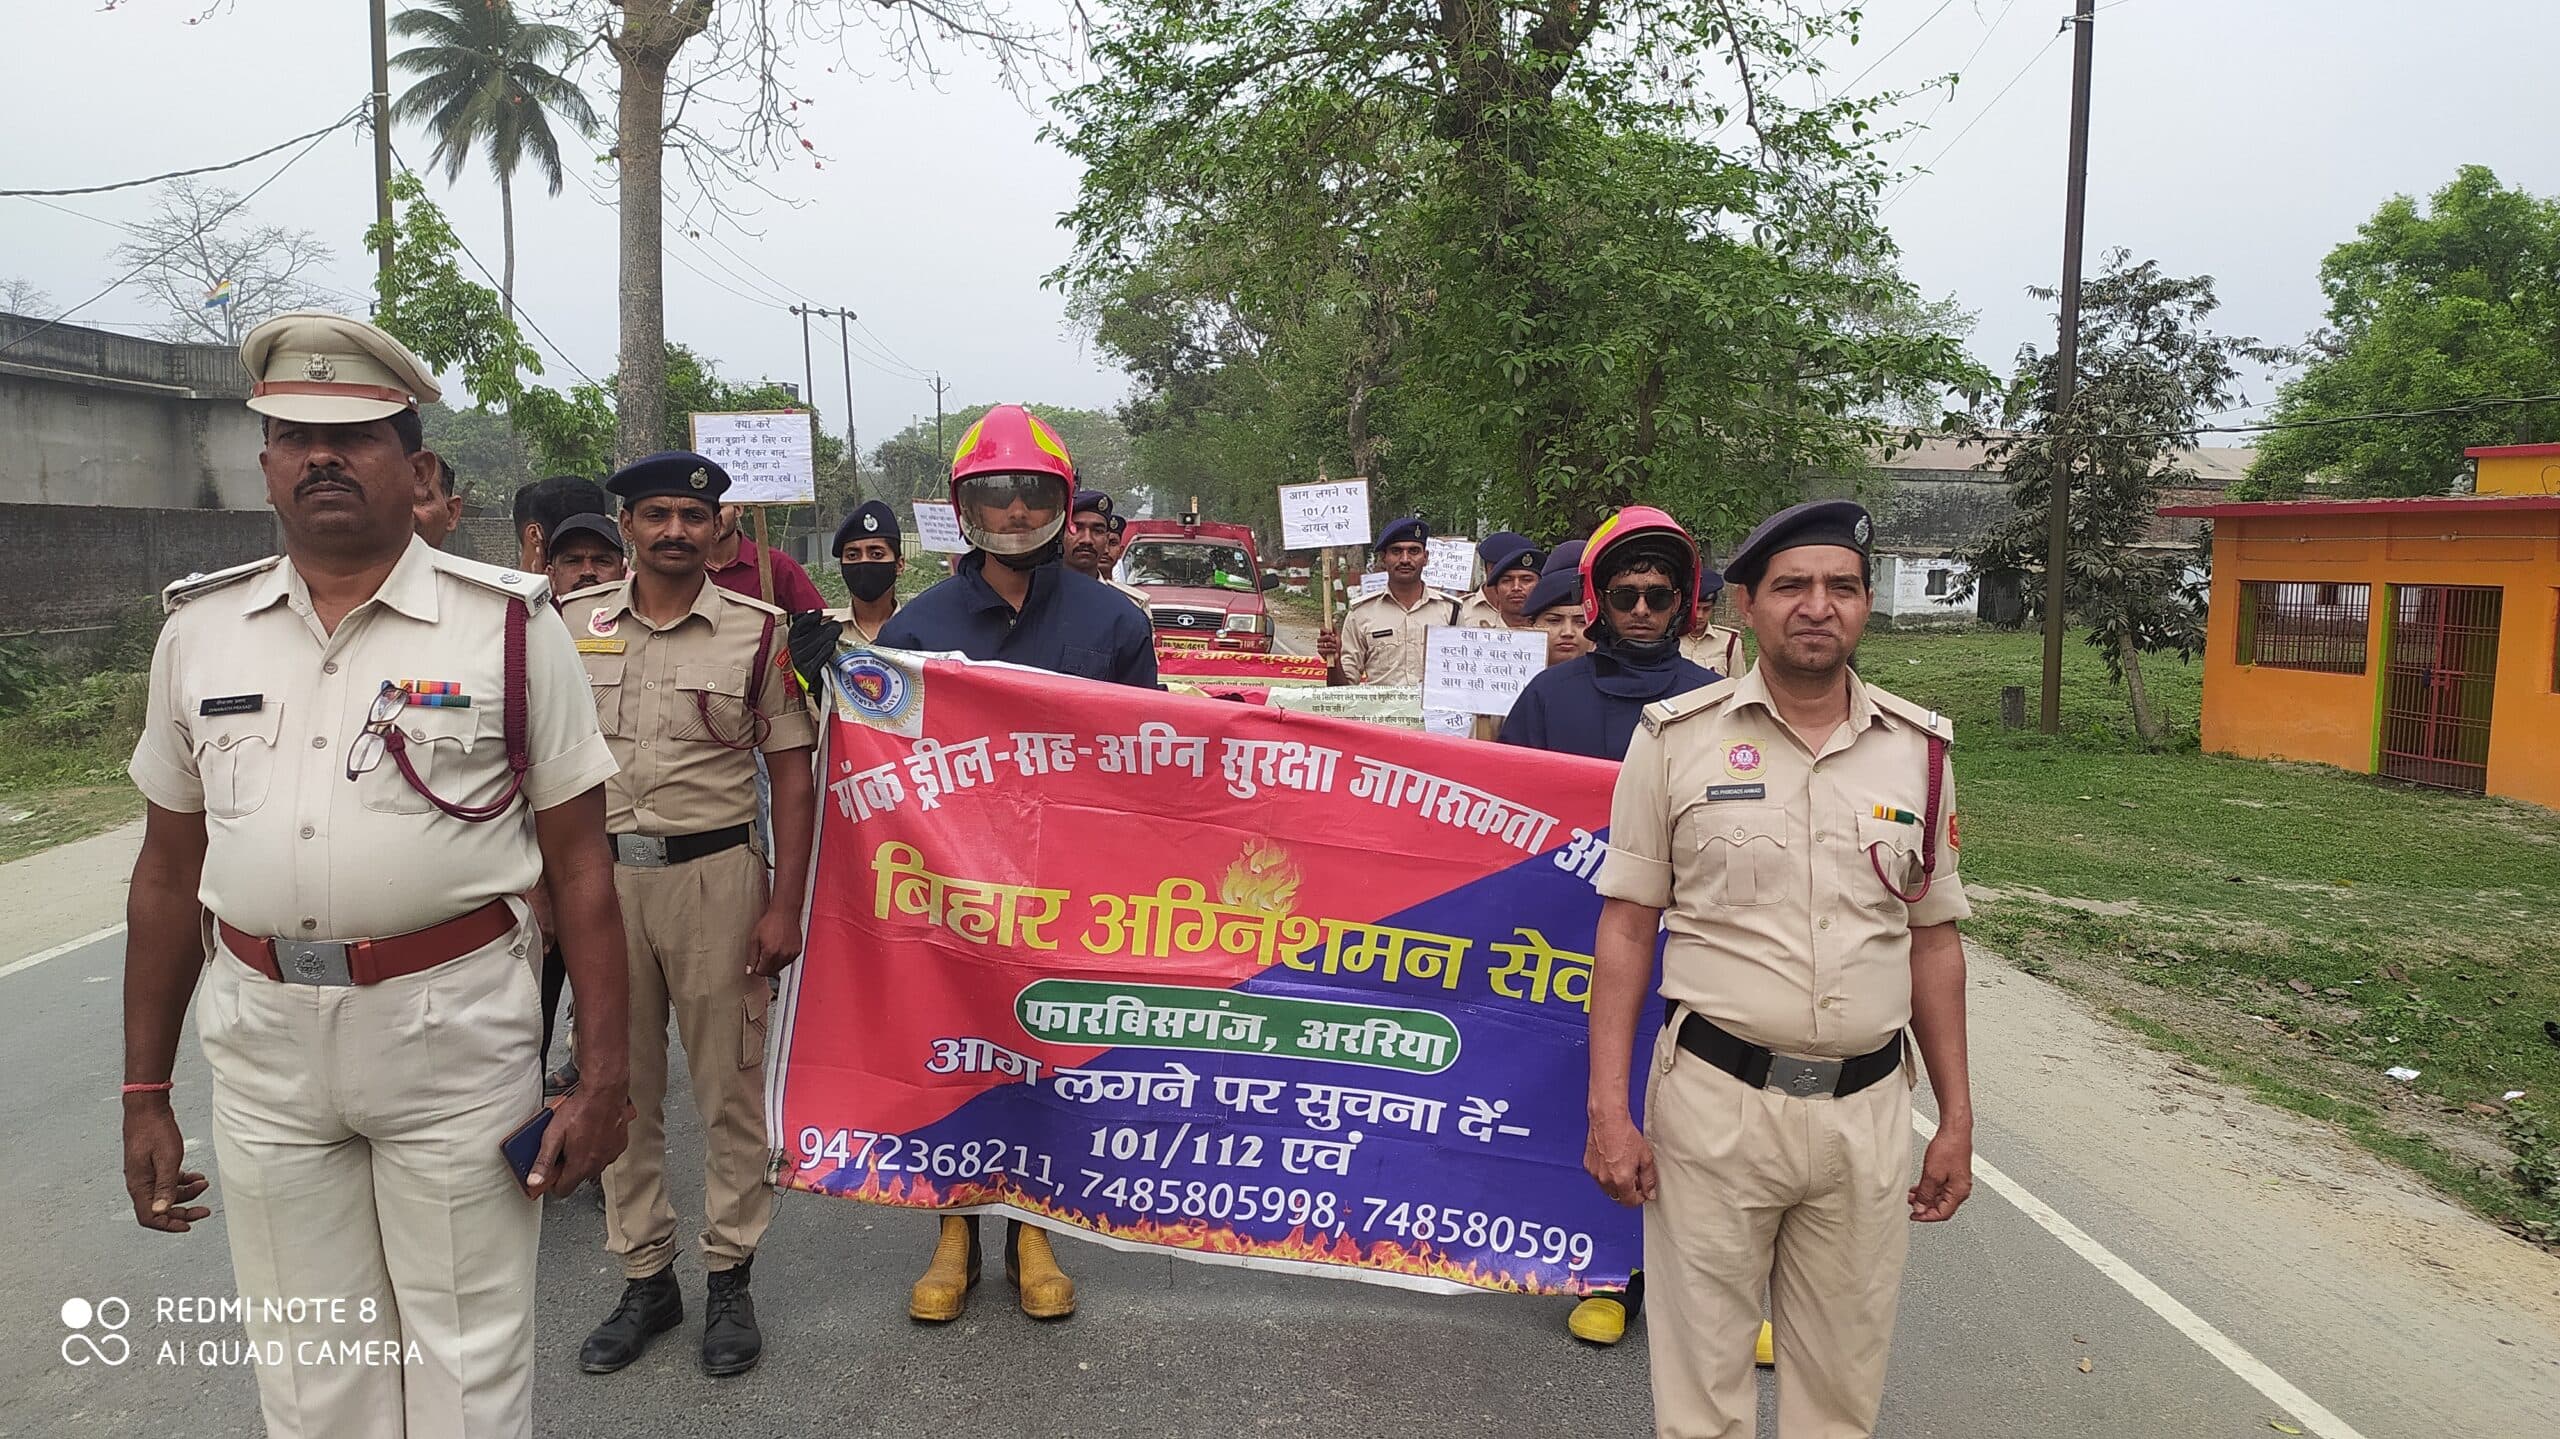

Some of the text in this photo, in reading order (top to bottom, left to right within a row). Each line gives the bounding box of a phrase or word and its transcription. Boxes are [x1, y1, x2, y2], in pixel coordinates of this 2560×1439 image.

[761, 434, 776, 445] लिए
[1288, 486, 1359, 500] आग लगने पर
[1302, 504, 1349, 518] 101/112
[1301, 519, 1351, 533] डायल करें
[1460, 630, 1513, 643] क्या न करें
[1440, 645, 1468, 657] कटनी
[1473, 646, 1483, 658] के
[1489, 650, 1507, 660] बाद
[1441, 677, 1461, 688] आग
[829, 760, 905, 824] मॉक
[1221, 736, 1342, 799] सुरक्षा
[1350, 755, 1560, 856] जागरूकता
[871, 840, 1071, 950] बिहार
[1079, 877, 1474, 990] अग्निशमन
[1296, 1018, 1451, 1067] अररिया
[926, 1036, 1042, 1087] आग
[1053, 1062, 1201, 1109] लगने
[1213, 1074, 1288, 1115] पर
[1295, 1082, 1447, 1132] सुचना
[1089, 1122, 1365, 1178] 101/112 एवं
[798, 1127, 1594, 1272] 9472368211, 7485805998, 748580599
